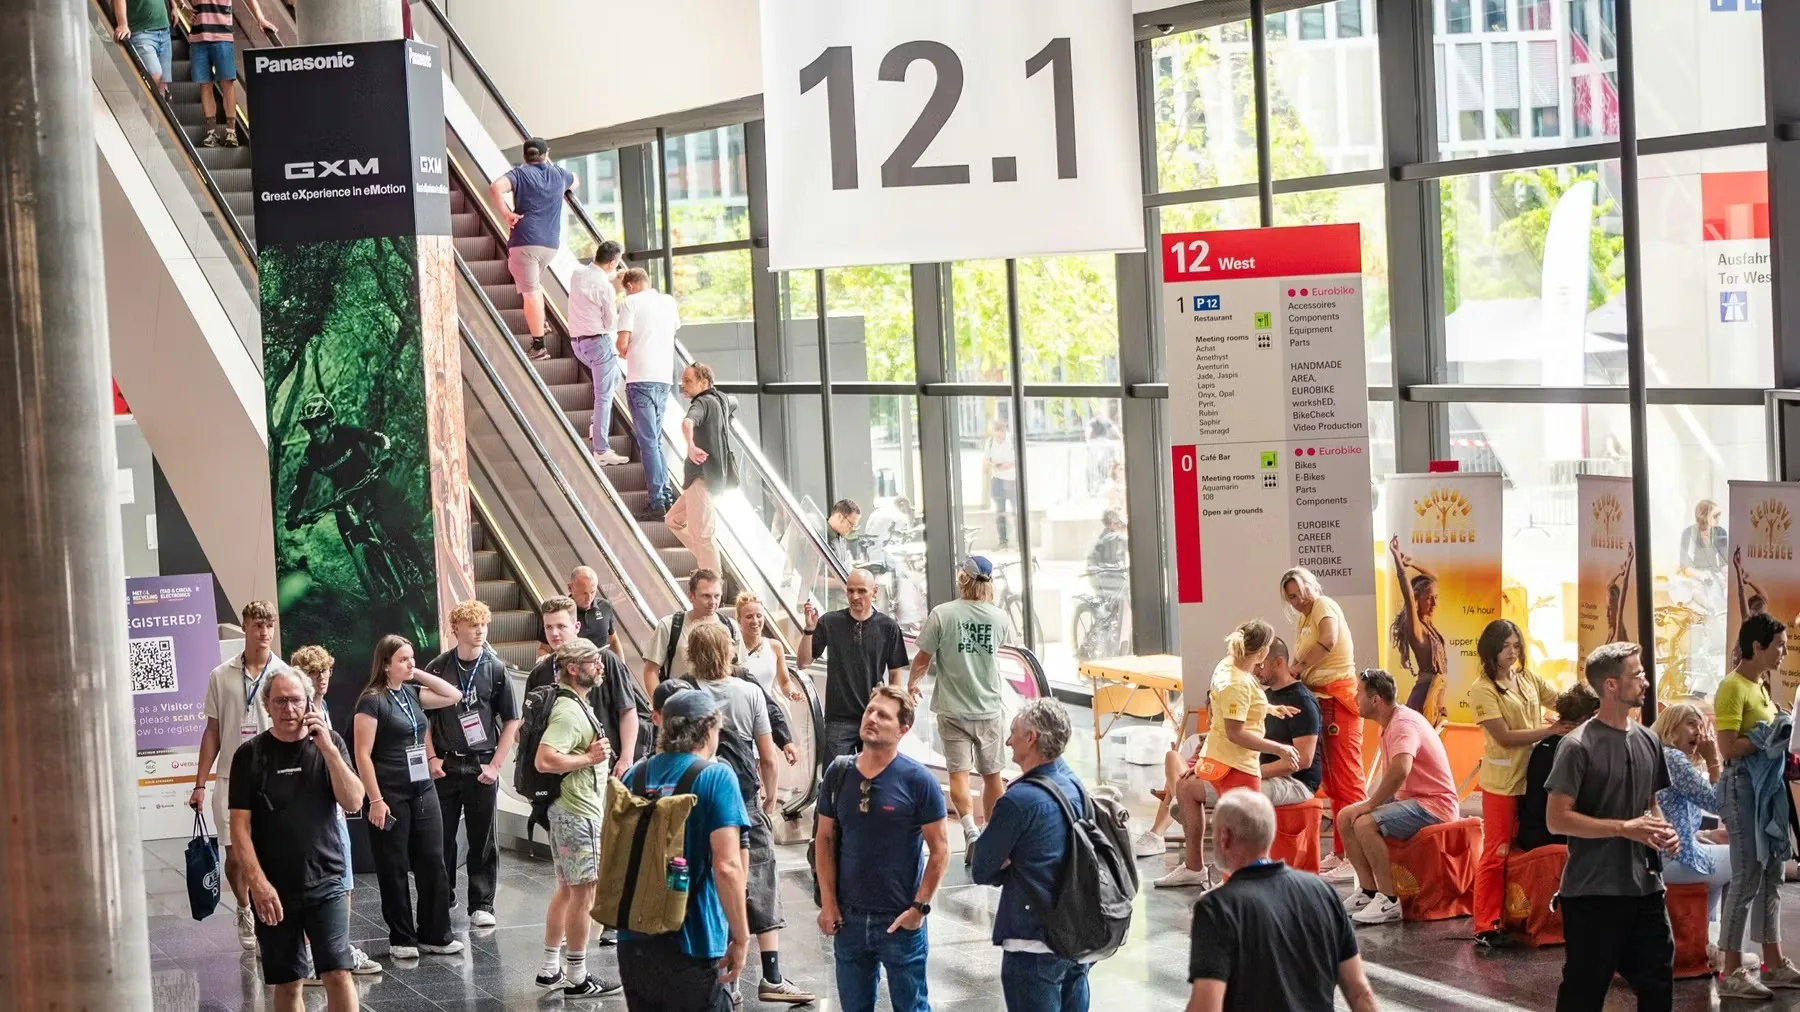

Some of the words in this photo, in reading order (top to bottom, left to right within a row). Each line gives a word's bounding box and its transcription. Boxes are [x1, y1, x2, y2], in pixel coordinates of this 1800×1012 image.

[255, 52, 355, 73] Panasonic
[799, 37, 1078, 190] 12.1
[284, 158, 380, 180] GXM
[420, 156, 442, 174] GXM
[261, 190, 290, 202] Great
[292, 188, 350, 200] eXperience
[352, 188, 362, 196] in
[364, 184, 406, 194] eMotion
[1171, 240, 1210, 273] 12
[1218, 257, 1256, 271] West
[1718, 252, 1770, 266] Ausfahr
[1717, 272, 1740, 284] Tor
[1744, 270, 1772, 284] Wes
[1312, 287, 1355, 296] Eurobike
[1176, 296, 1184, 314] 1
[1196, 299, 1205, 308] P
[1206, 298, 1218, 308] 12
[1288, 301, 1336, 310] Accessoires
[1193, 314, 1232, 322] Restaurant
[1288, 313, 1340, 323] Components
[1290, 326, 1333, 335] Equipment
[1290, 339, 1310, 347] Parts
[1291, 360, 1342, 370] HANDMADE
[1291, 374, 1317, 383] AREA,
[1292, 385, 1335, 395] EUROBIKE
[1292, 398, 1336, 407] workshED,
[1293, 410, 1335, 420] BikeCheck
[1293, 423, 1316, 432] Video
[1318, 421, 1362, 430] Production
[1319, 447, 1362, 456] Eurobike
[1181, 455, 1193, 472] 0
[1295, 461, 1317, 469] Bikes
[1202, 484, 1239, 492] Aquamarin
[1296, 497, 1348, 507] Components
[1234, 507, 1264, 515] grounds
[1298, 520, 1340, 529] EUROBIKE
[1298, 533, 1332, 541] CAREER
[1298, 545, 1334, 554] CENTER,
[1299, 557, 1342, 566] EUROBIKE
[1311, 568, 1352, 577] MARKET
[1463, 606, 1475, 615] 1/4
[1477, 606, 1495, 615] hour
[127, 614, 201, 629] EGISTERED?
[160, 703, 193, 711] Visitor
[140, 716, 170, 726] please
[172, 713, 195, 722] scan
[154, 727, 164, 735] to
[167, 724, 202, 734] register
